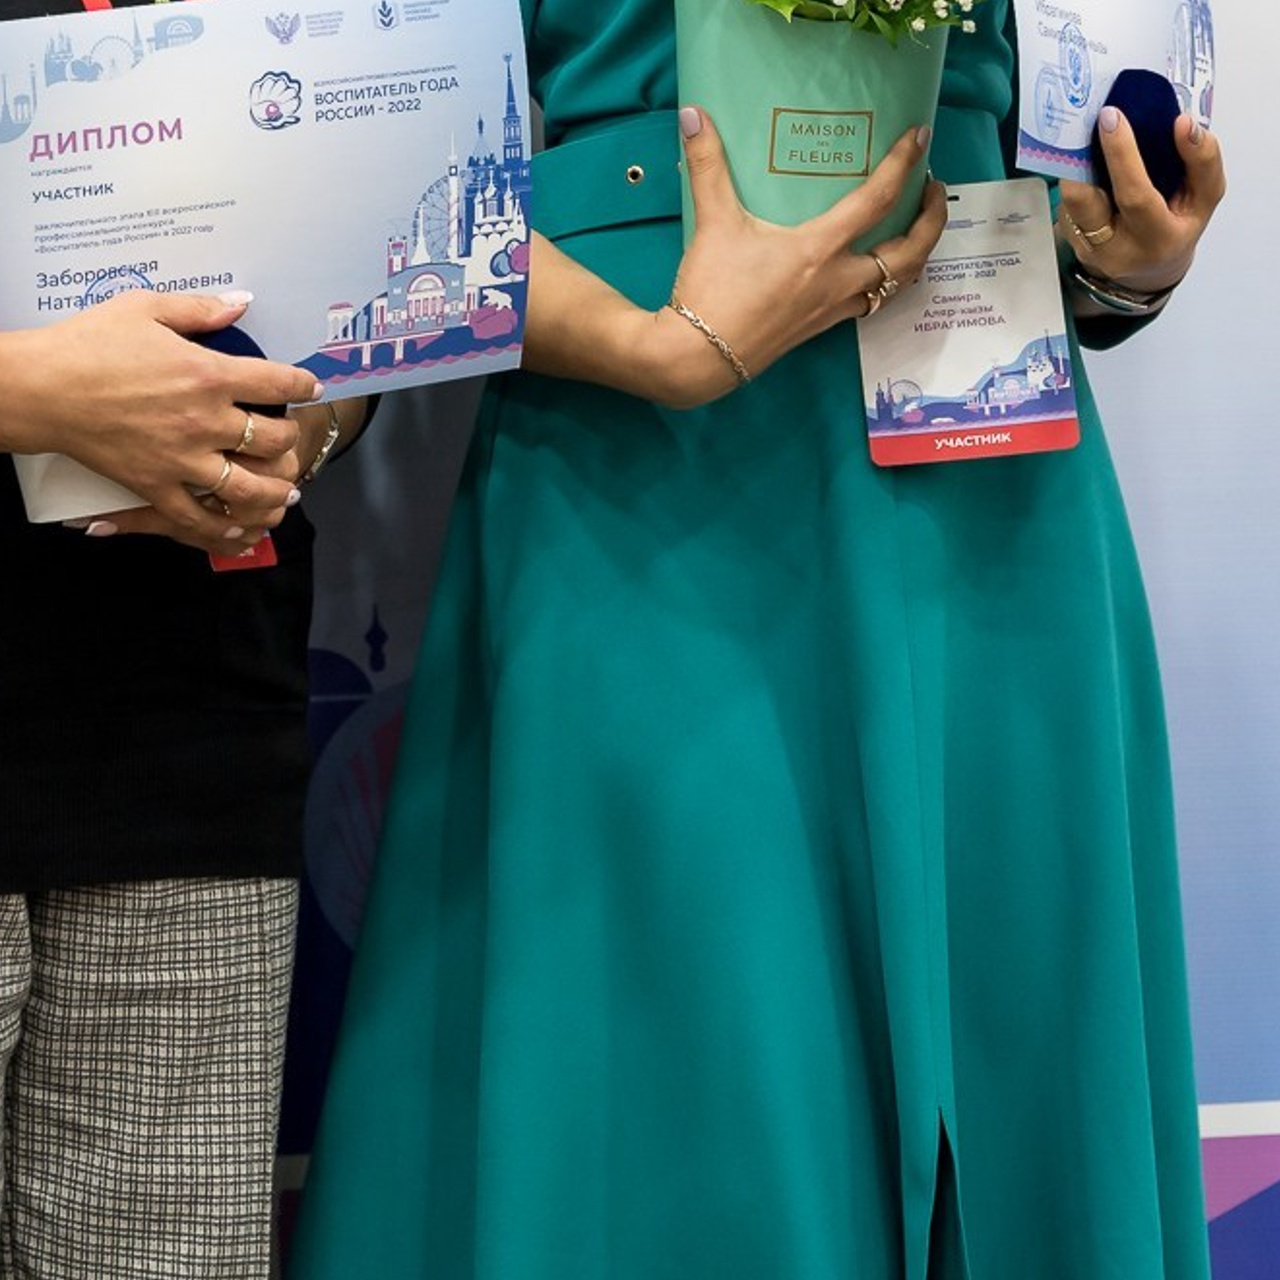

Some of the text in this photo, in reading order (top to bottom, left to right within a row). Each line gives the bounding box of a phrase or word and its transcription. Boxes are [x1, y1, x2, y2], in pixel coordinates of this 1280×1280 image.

[314, 76, 460, 106] ВОСПИТАТЕЛЬ ГОДА
[315, 104, 375, 123] РОССИИ
[388, 97, 422, 114] 2022
[790, 122, 856, 137] MAISON
[29, 118, 184, 162] ДИПЛОМ
[788, 150, 854, 163] FLEURS
[32, 183, 115, 203] УЧАСТНИК
[171, 226, 192, 237] 2022
[36, 260, 158, 291] Заборовская
[931, 292, 981, 304] Самира
[914, 314, 1007, 333] ИБРАГИМОВА
[934, 432, 1012, 450] УЧАСТНИК
